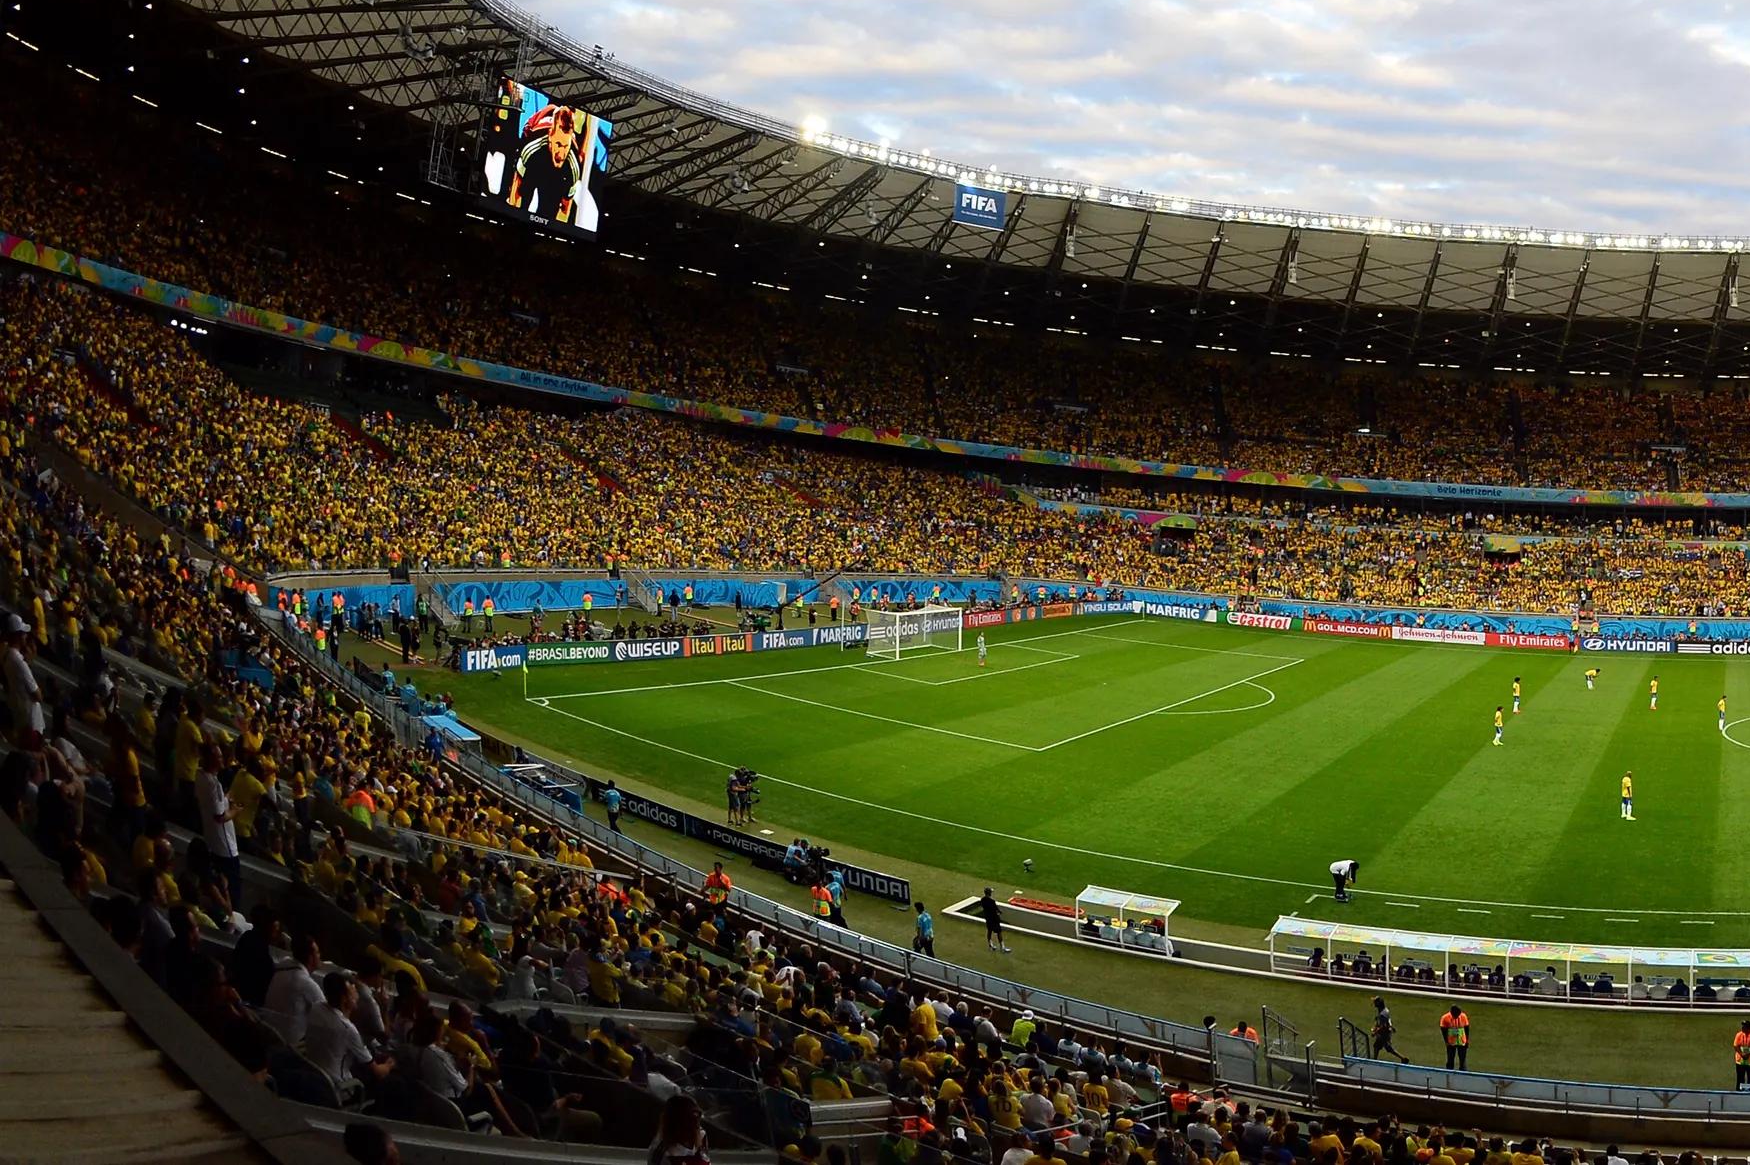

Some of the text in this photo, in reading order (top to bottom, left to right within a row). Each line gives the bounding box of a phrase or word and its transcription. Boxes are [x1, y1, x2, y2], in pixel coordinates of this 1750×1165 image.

[961, 192, 998, 214] FIFA
[529, 214, 549, 226] SONY
[1437, 486, 1502, 497] Belo Horizonte
[1107, 601, 1132, 612] SOLAR
[1146, 602, 1200, 620] MARFRIG
[1238, 612, 1290, 630] Castrol
[820, 624, 862, 640] MARFRIG
[1317, 623, 1379, 636] GOL.MCD.COM
[691, 634, 745, 655] Itaú Itaú
[1499, 634, 1565, 647] Fly Emirates
[1607, 639, 1671, 652] HYUNDAI
[528, 645, 609, 662] #BRASILBEYOND
[627, 641, 680, 656] WISEUP
[628, 797, 677, 828] adidas
[713, 829, 786, 859] POWERADE
[1089, 1092, 1101, 1106] 10
